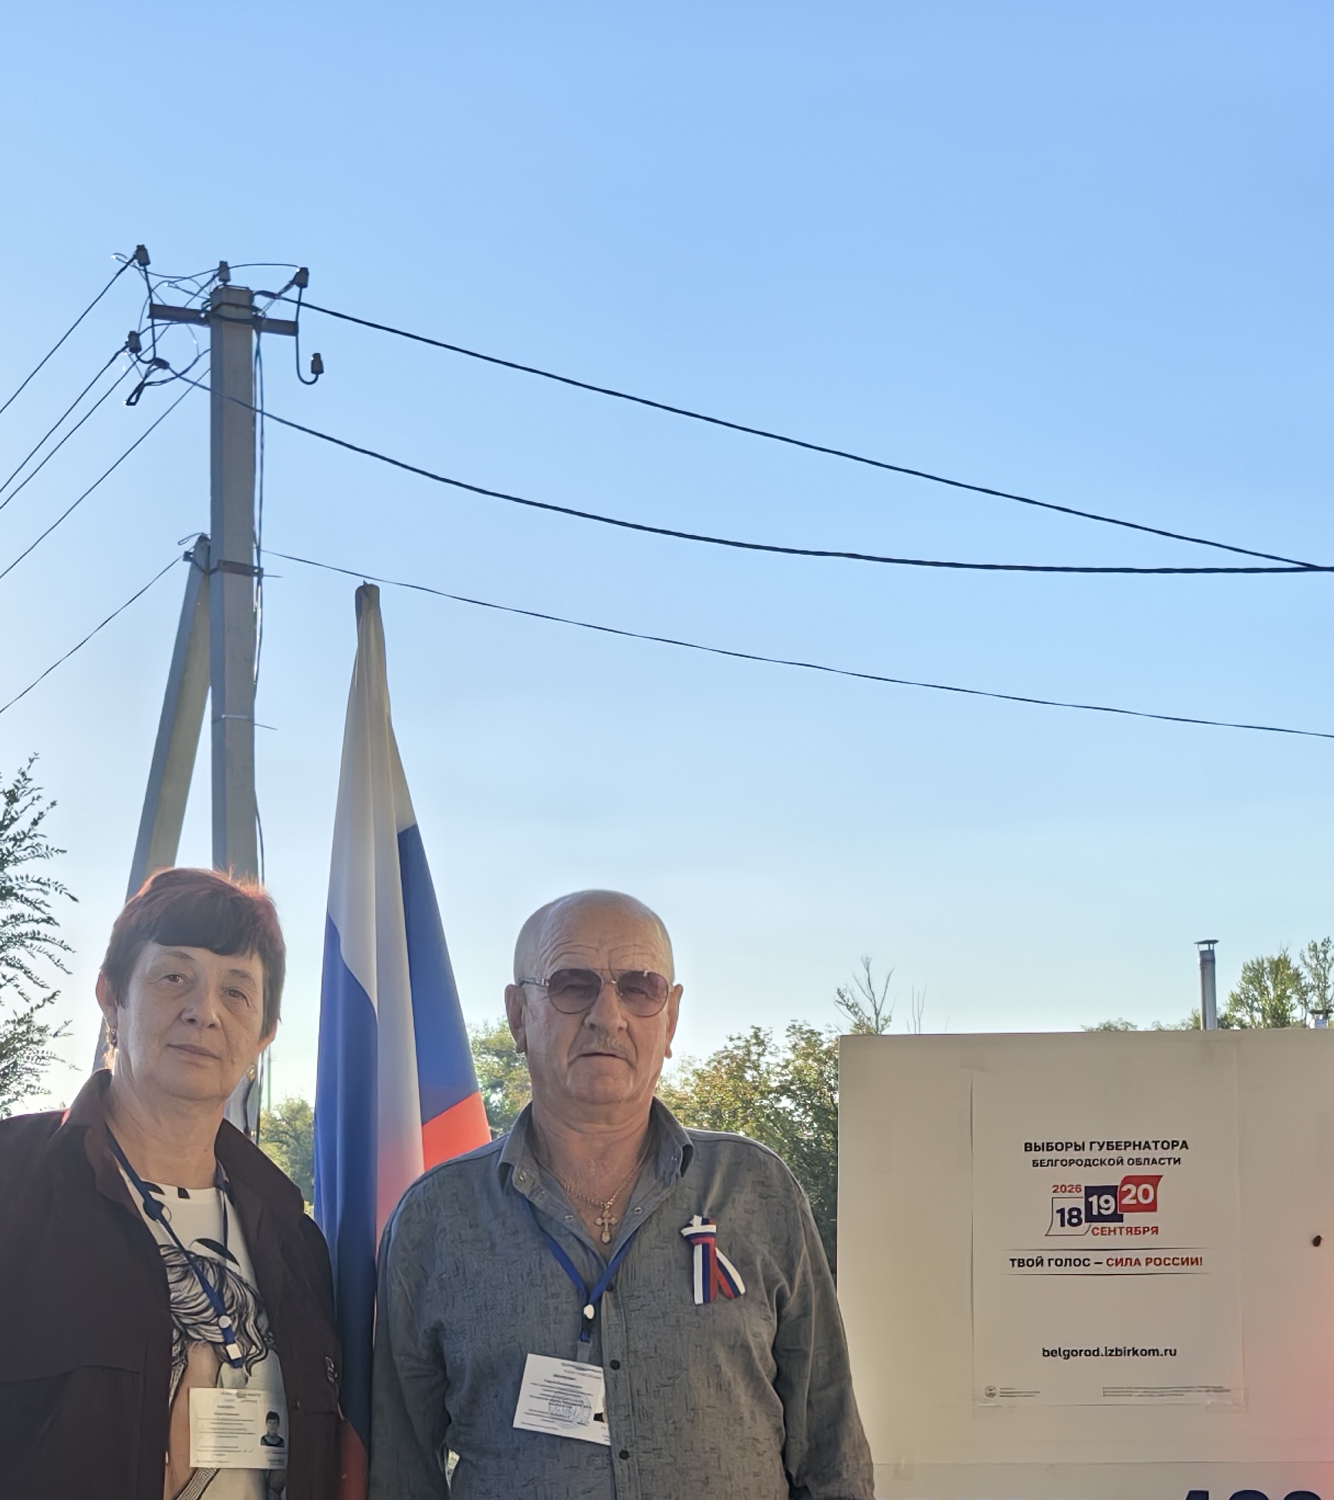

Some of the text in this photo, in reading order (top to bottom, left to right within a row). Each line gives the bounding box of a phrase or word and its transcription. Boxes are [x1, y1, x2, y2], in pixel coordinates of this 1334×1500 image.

[1024, 1140, 1189, 1152] ВЫБОРЫ ГУБЕРНАТОРА
[1032, 1156, 1182, 1168] БЕЛГОРОДСКОЙ ОБЛАСТИ
[1052, 1184, 1083, 1194] 2026
[1121, 1183, 1155, 1205] 20
[1088, 1194, 1116, 1216] 19
[1055, 1206, 1083, 1228] 18
[1091, 1225, 1159, 1237] СЕНТЯБРЯ
[1009, 1256, 1045, 1268] ТВОЙ
[1047, 1257, 1091, 1268] ГОЛОС
[1105, 1257, 1142, 1267] СИЛА
[1144, 1256, 1203, 1267] РОССИИ!
[1042, 1345, 1177, 1361] belgorod.izbirkom.ru
